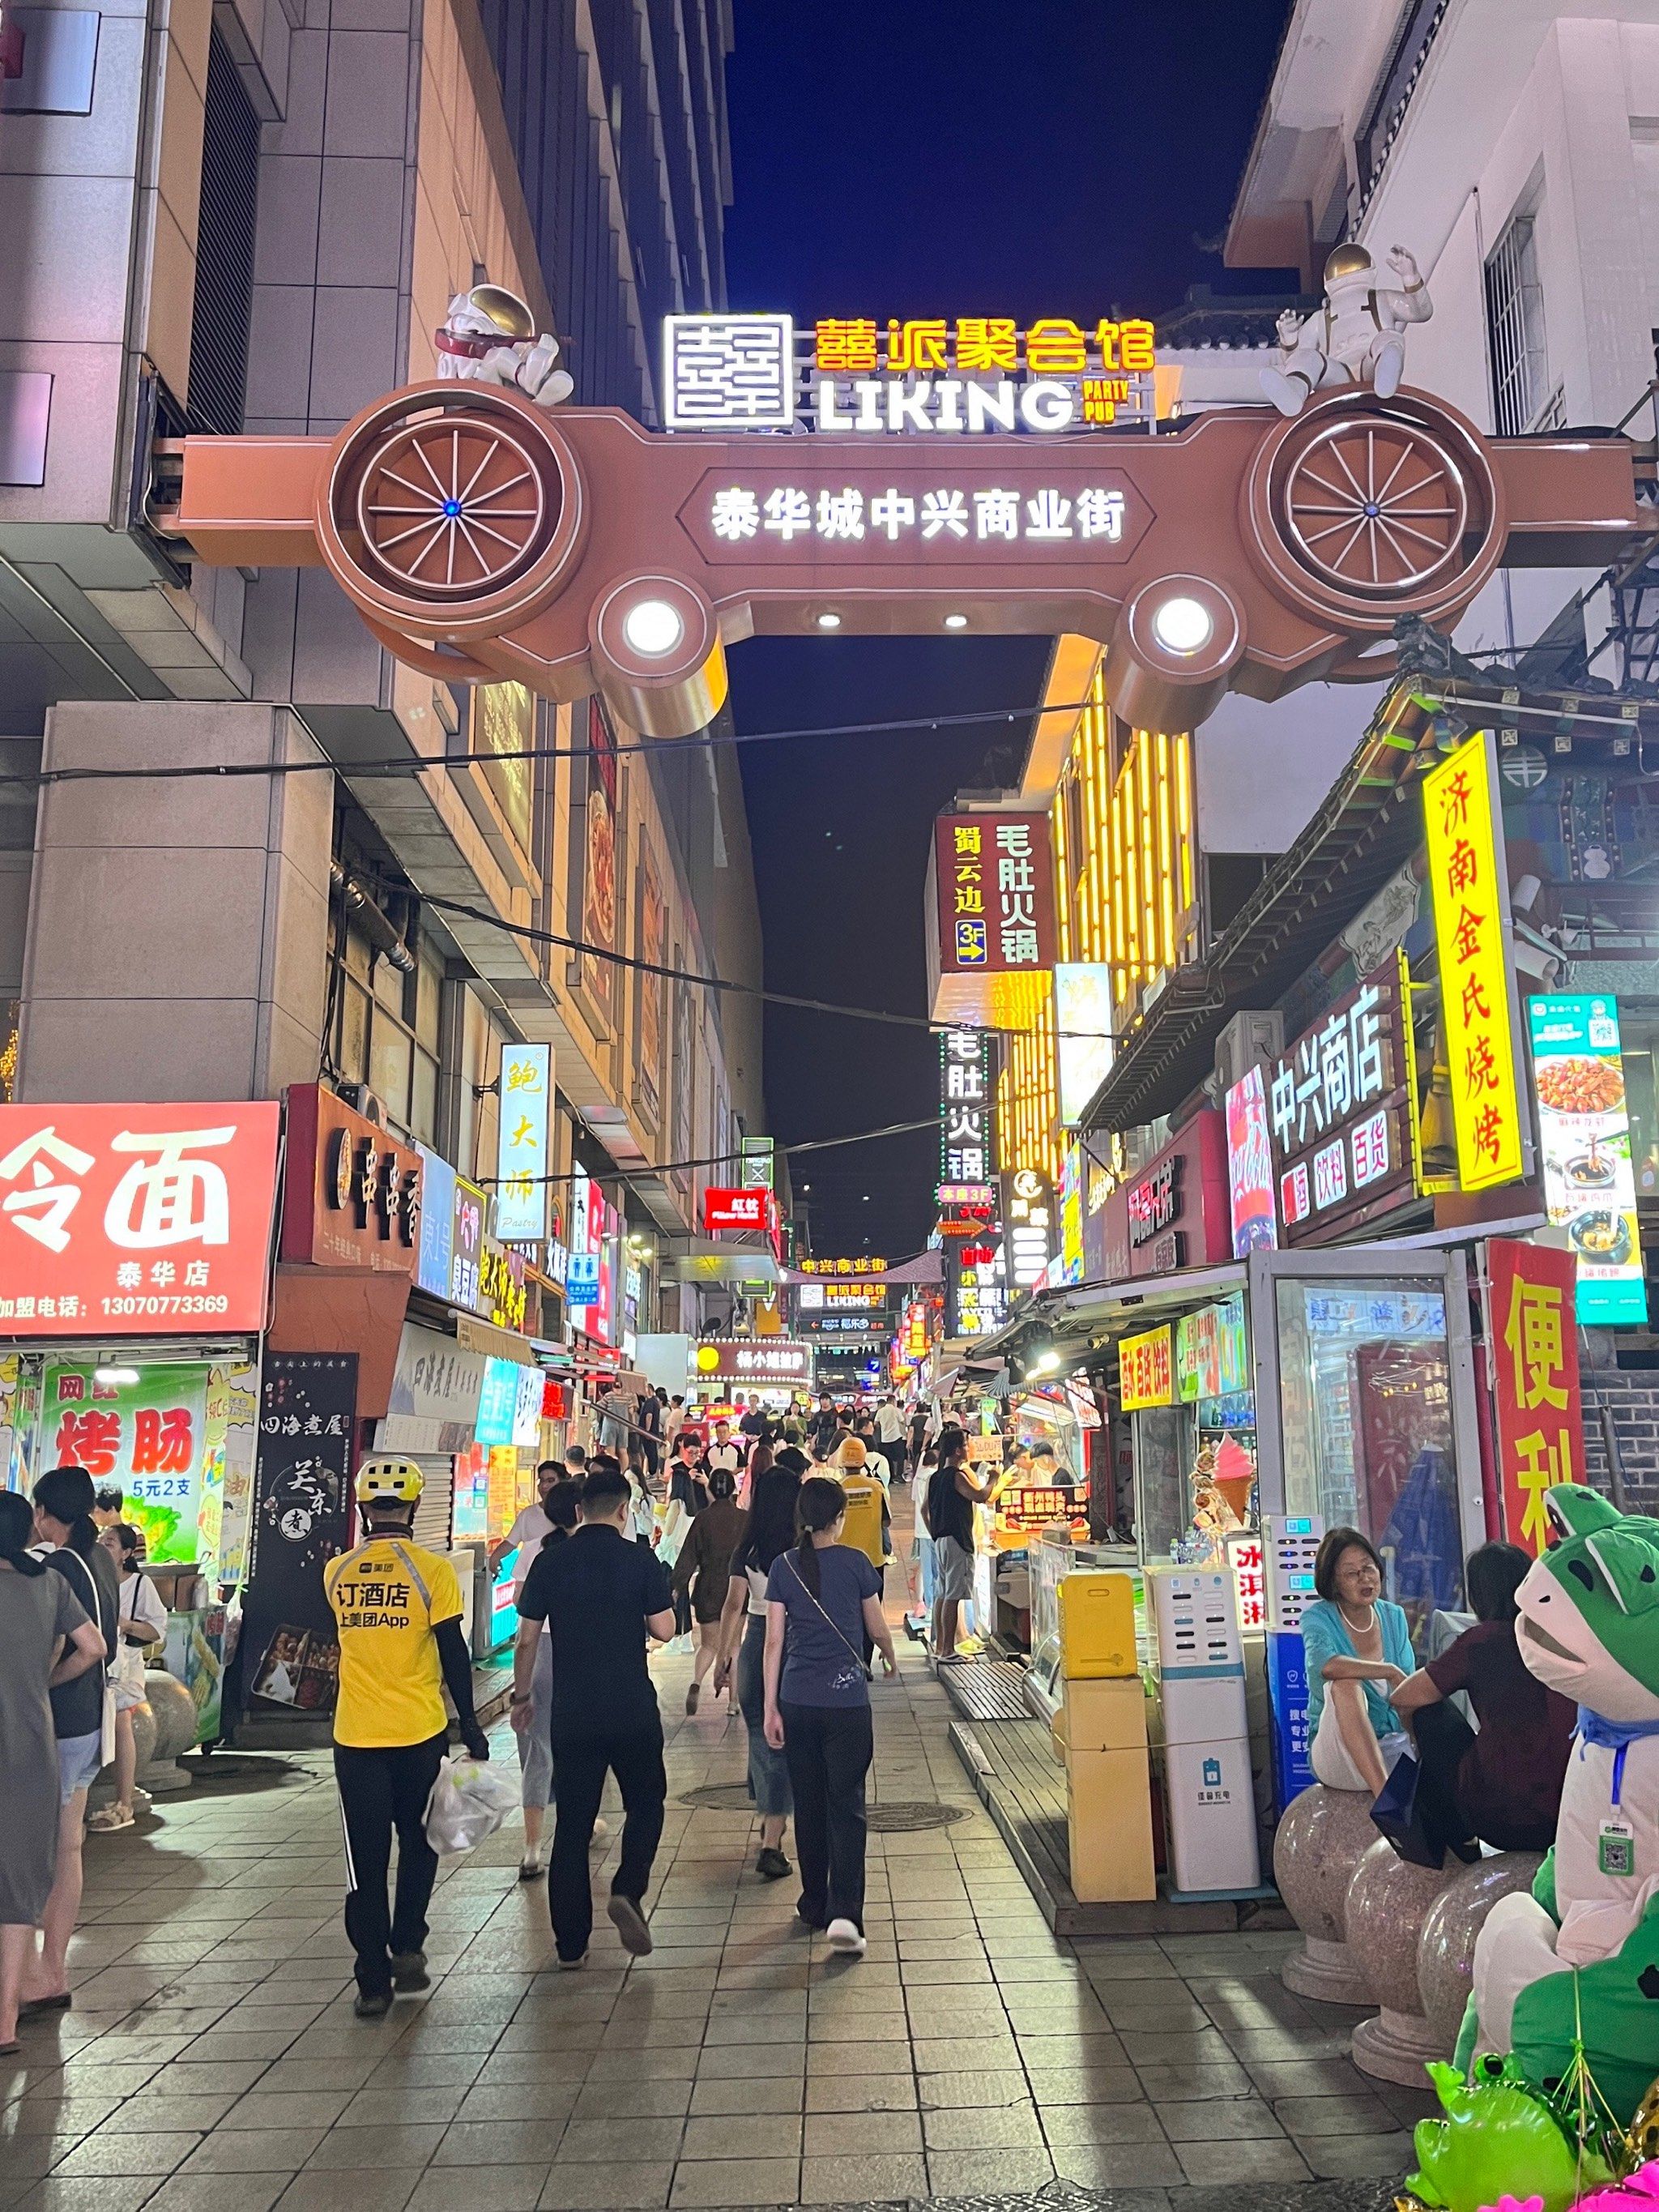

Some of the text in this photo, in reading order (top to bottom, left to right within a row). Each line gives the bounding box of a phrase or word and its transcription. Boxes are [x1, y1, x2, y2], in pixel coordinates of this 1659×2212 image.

[820, 380, 1073, 430] LIKING
[1083, 380, 1128, 400] PARTY
[1085, 400, 1115, 422] PUB
[711, 488, 1125, 541] 泰华城中兴商业街
[953, 826, 984, 914] 蜀云边
[996, 823, 1039, 964] 毛肚火锅
[959, 923, 983, 944] 3F
[1439, 770, 1503, 1168] 济南金氏烧烤
[1271, 984, 1385, 1155] 中兴商店
[947, 1031, 984, 1181] 毛肚火锅
[505, 1061, 543, 1205] 鲍大师
[1353, 1114, 1386, 1181] 百货
[1316, 1143, 1345, 1203] 饮料
[502, 1216, 539, 1229] Pastry
[116, 1261, 211, 1290] 泰华店
[801, 1258, 885, 1275] 中兴商业街
[100, 1296, 228, 1314] 13070773369
[56, 1407, 194, 1476] 烤肠
[260, 1413, 343, 1437] 四海煮屋
[132, 1477, 191, 1497] 5元2支
[279, 1458, 333, 1535] 关东煮
[373, 1563, 394, 1573] 美团
[337, 1582, 411, 1608] 订酒店
[339, 1612, 410, 1629] 上美团App
